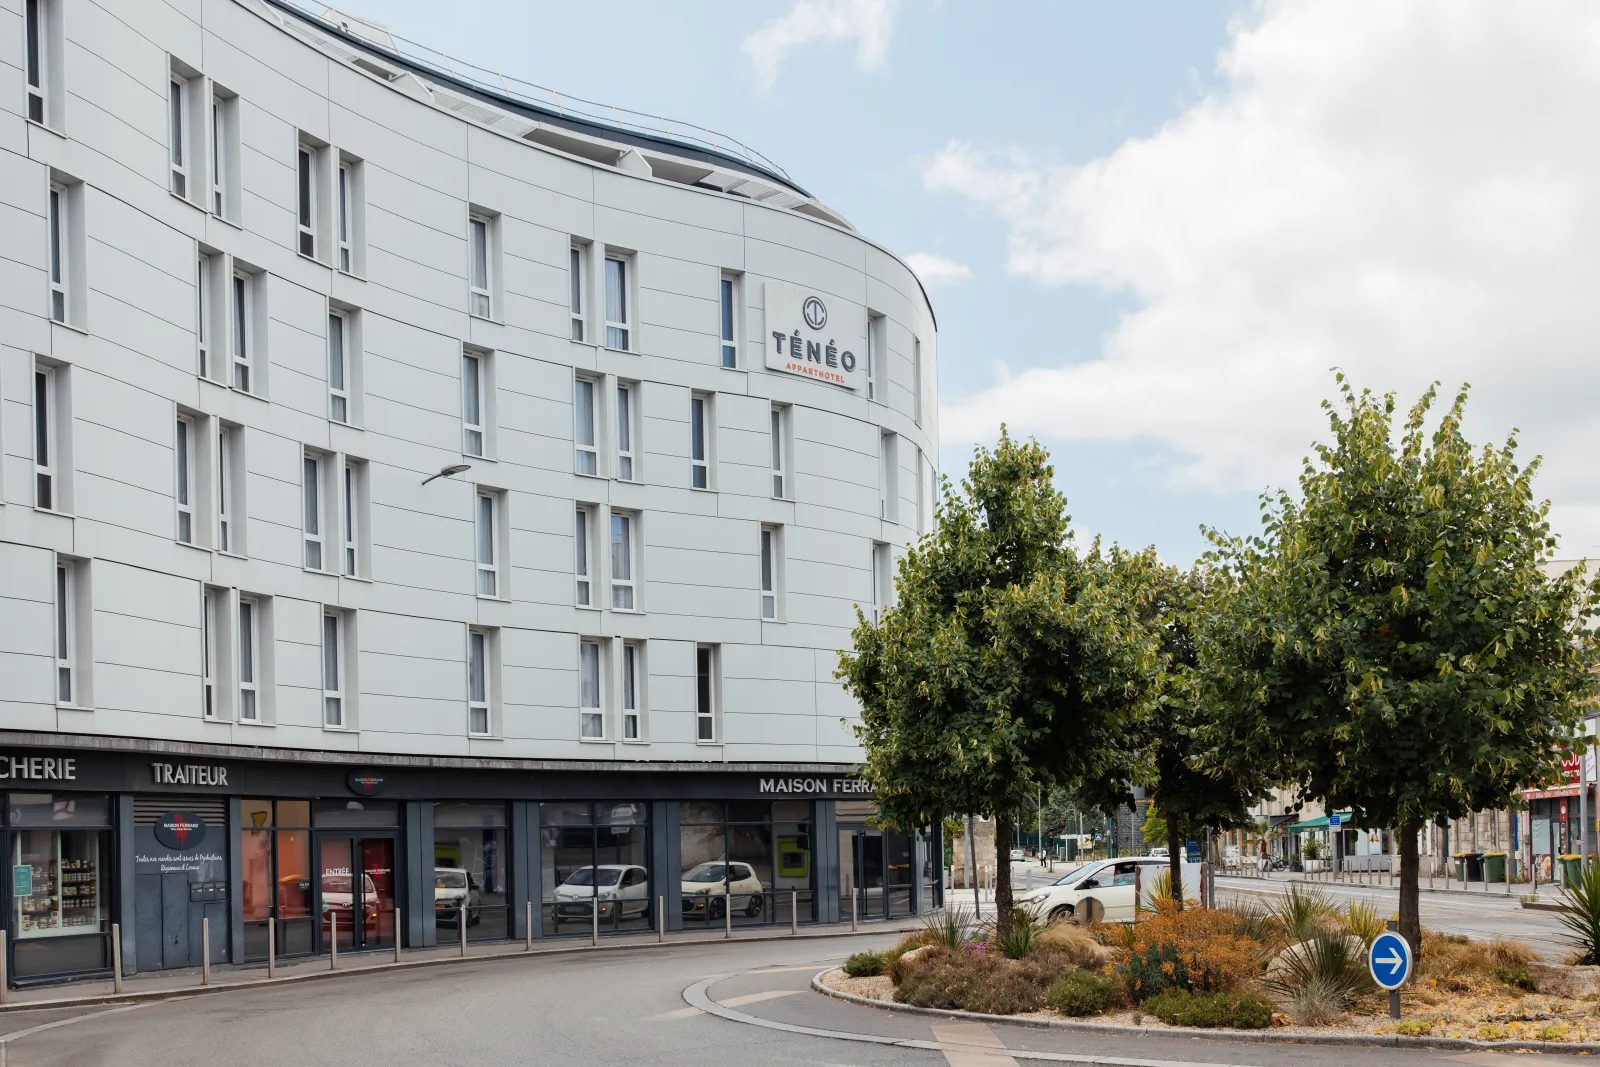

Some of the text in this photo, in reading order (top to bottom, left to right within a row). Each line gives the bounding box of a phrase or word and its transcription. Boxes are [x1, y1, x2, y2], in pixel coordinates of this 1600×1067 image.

[772, 329, 856, 373] TÉNÉO
[785, 362, 845, 383] APPARTHOTEL
[0, 756, 76, 780] CHERIE
[151, 762, 229, 786] TRAITEUR
[759, 778, 827, 793] MAISON
[325, 866, 350, 876] ENTRÉE
